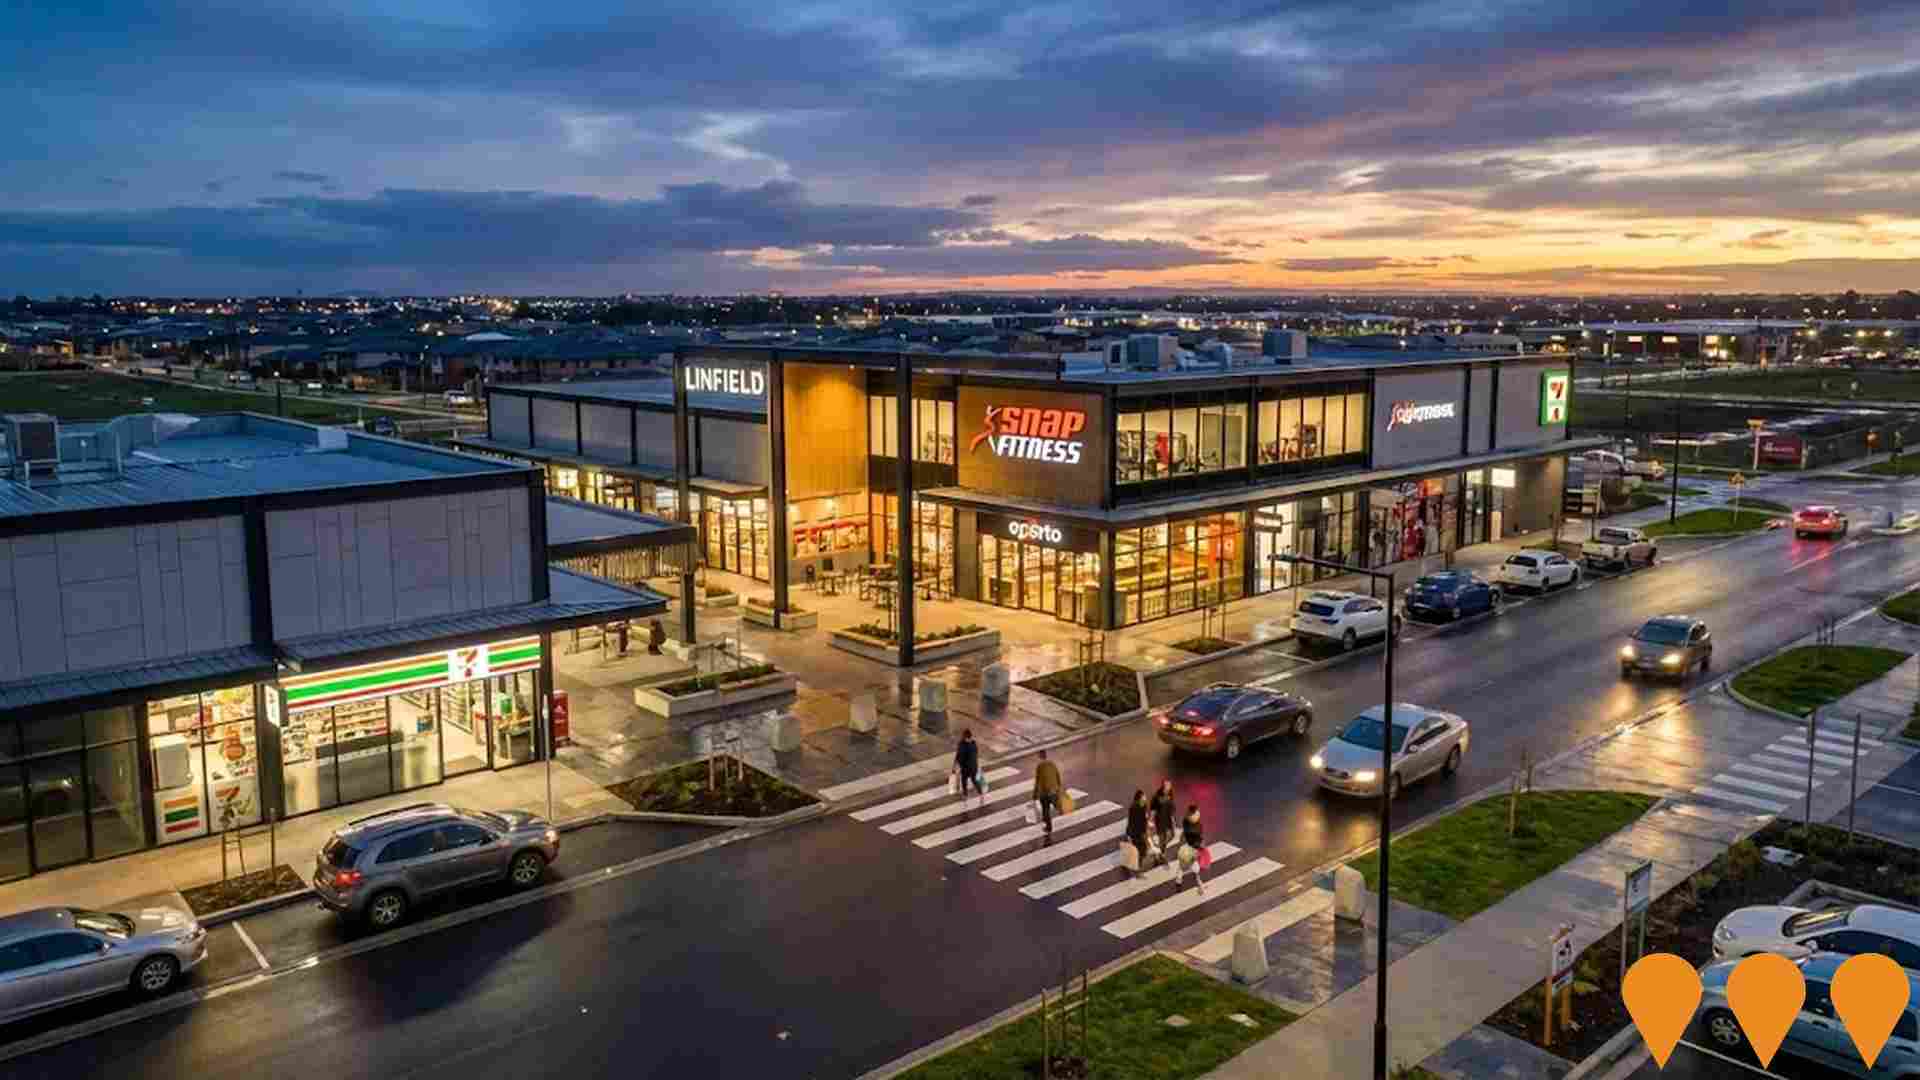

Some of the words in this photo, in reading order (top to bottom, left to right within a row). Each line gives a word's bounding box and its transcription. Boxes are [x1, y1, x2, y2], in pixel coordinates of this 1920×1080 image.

[686, 366, 764, 395] LINFIELD
[997, 435, 1082, 464] FITNESS
[456, 647, 478, 679] 7
